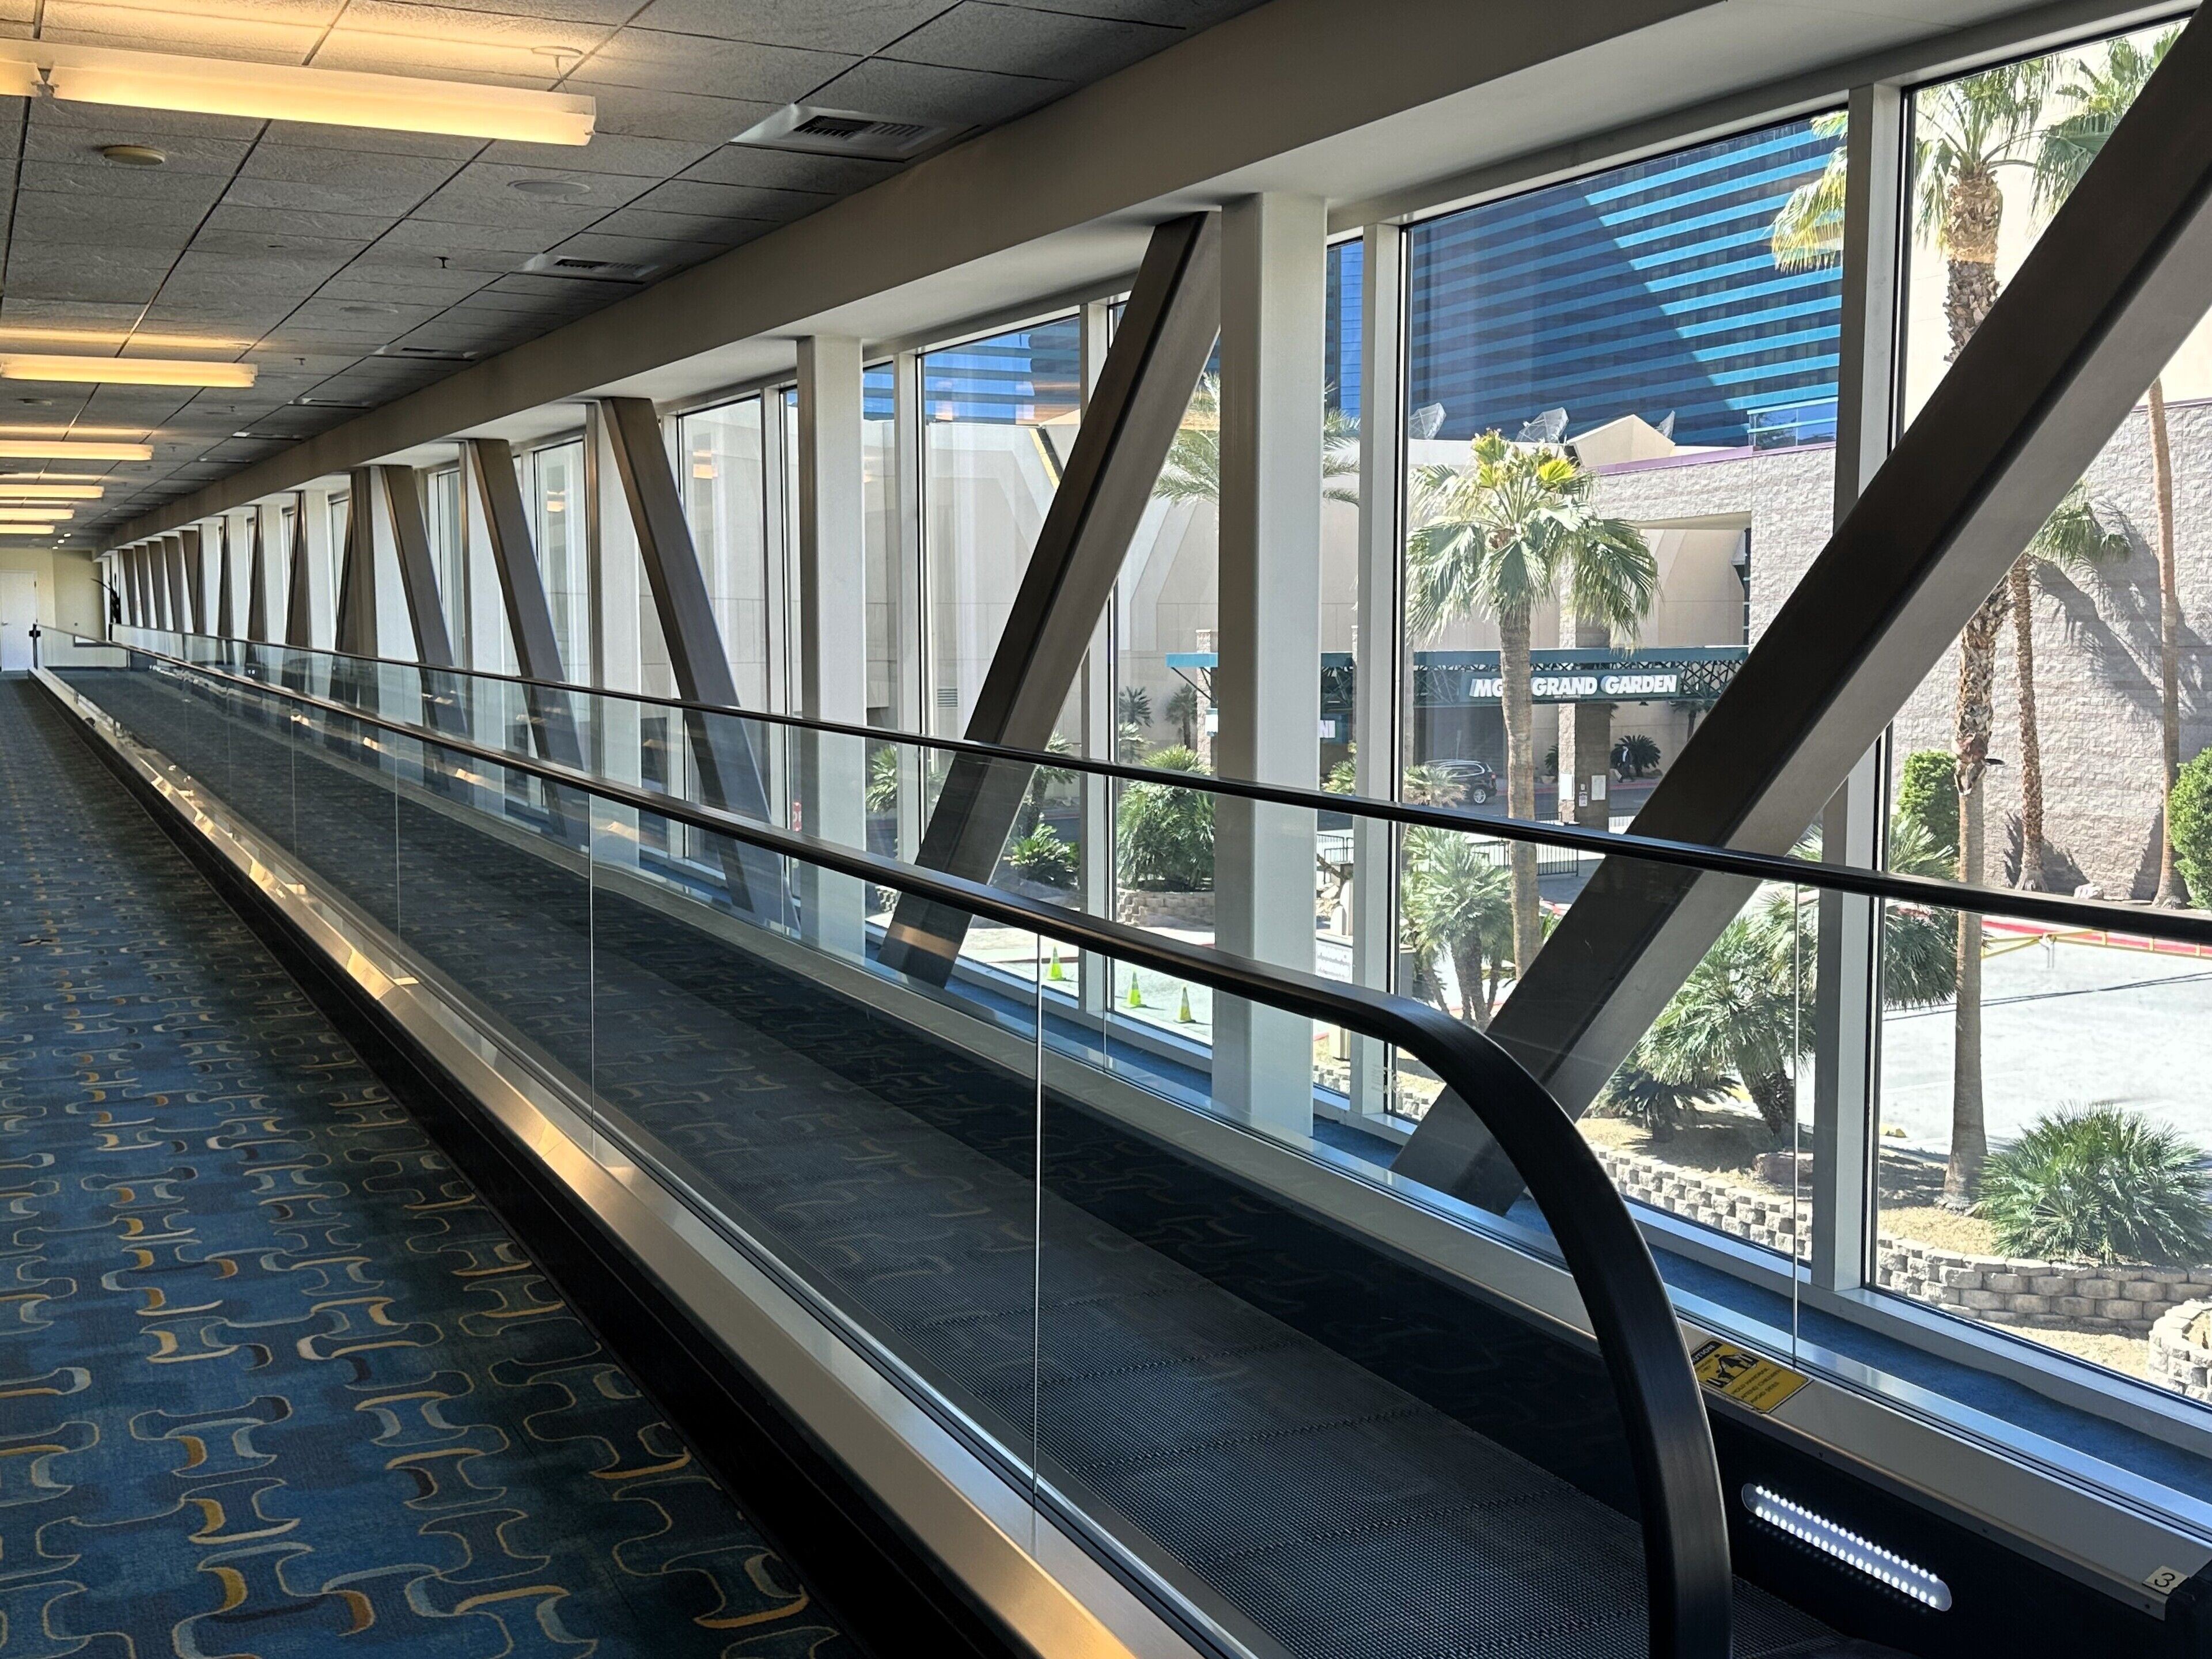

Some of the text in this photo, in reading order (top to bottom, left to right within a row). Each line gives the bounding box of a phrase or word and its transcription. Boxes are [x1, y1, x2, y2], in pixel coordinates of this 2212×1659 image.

[1470, 675, 1677, 698] MG GRAND GARDEN
[1691, 1344, 1716, 1363] AUTION
[2154, 1573, 2176, 1587] 3
